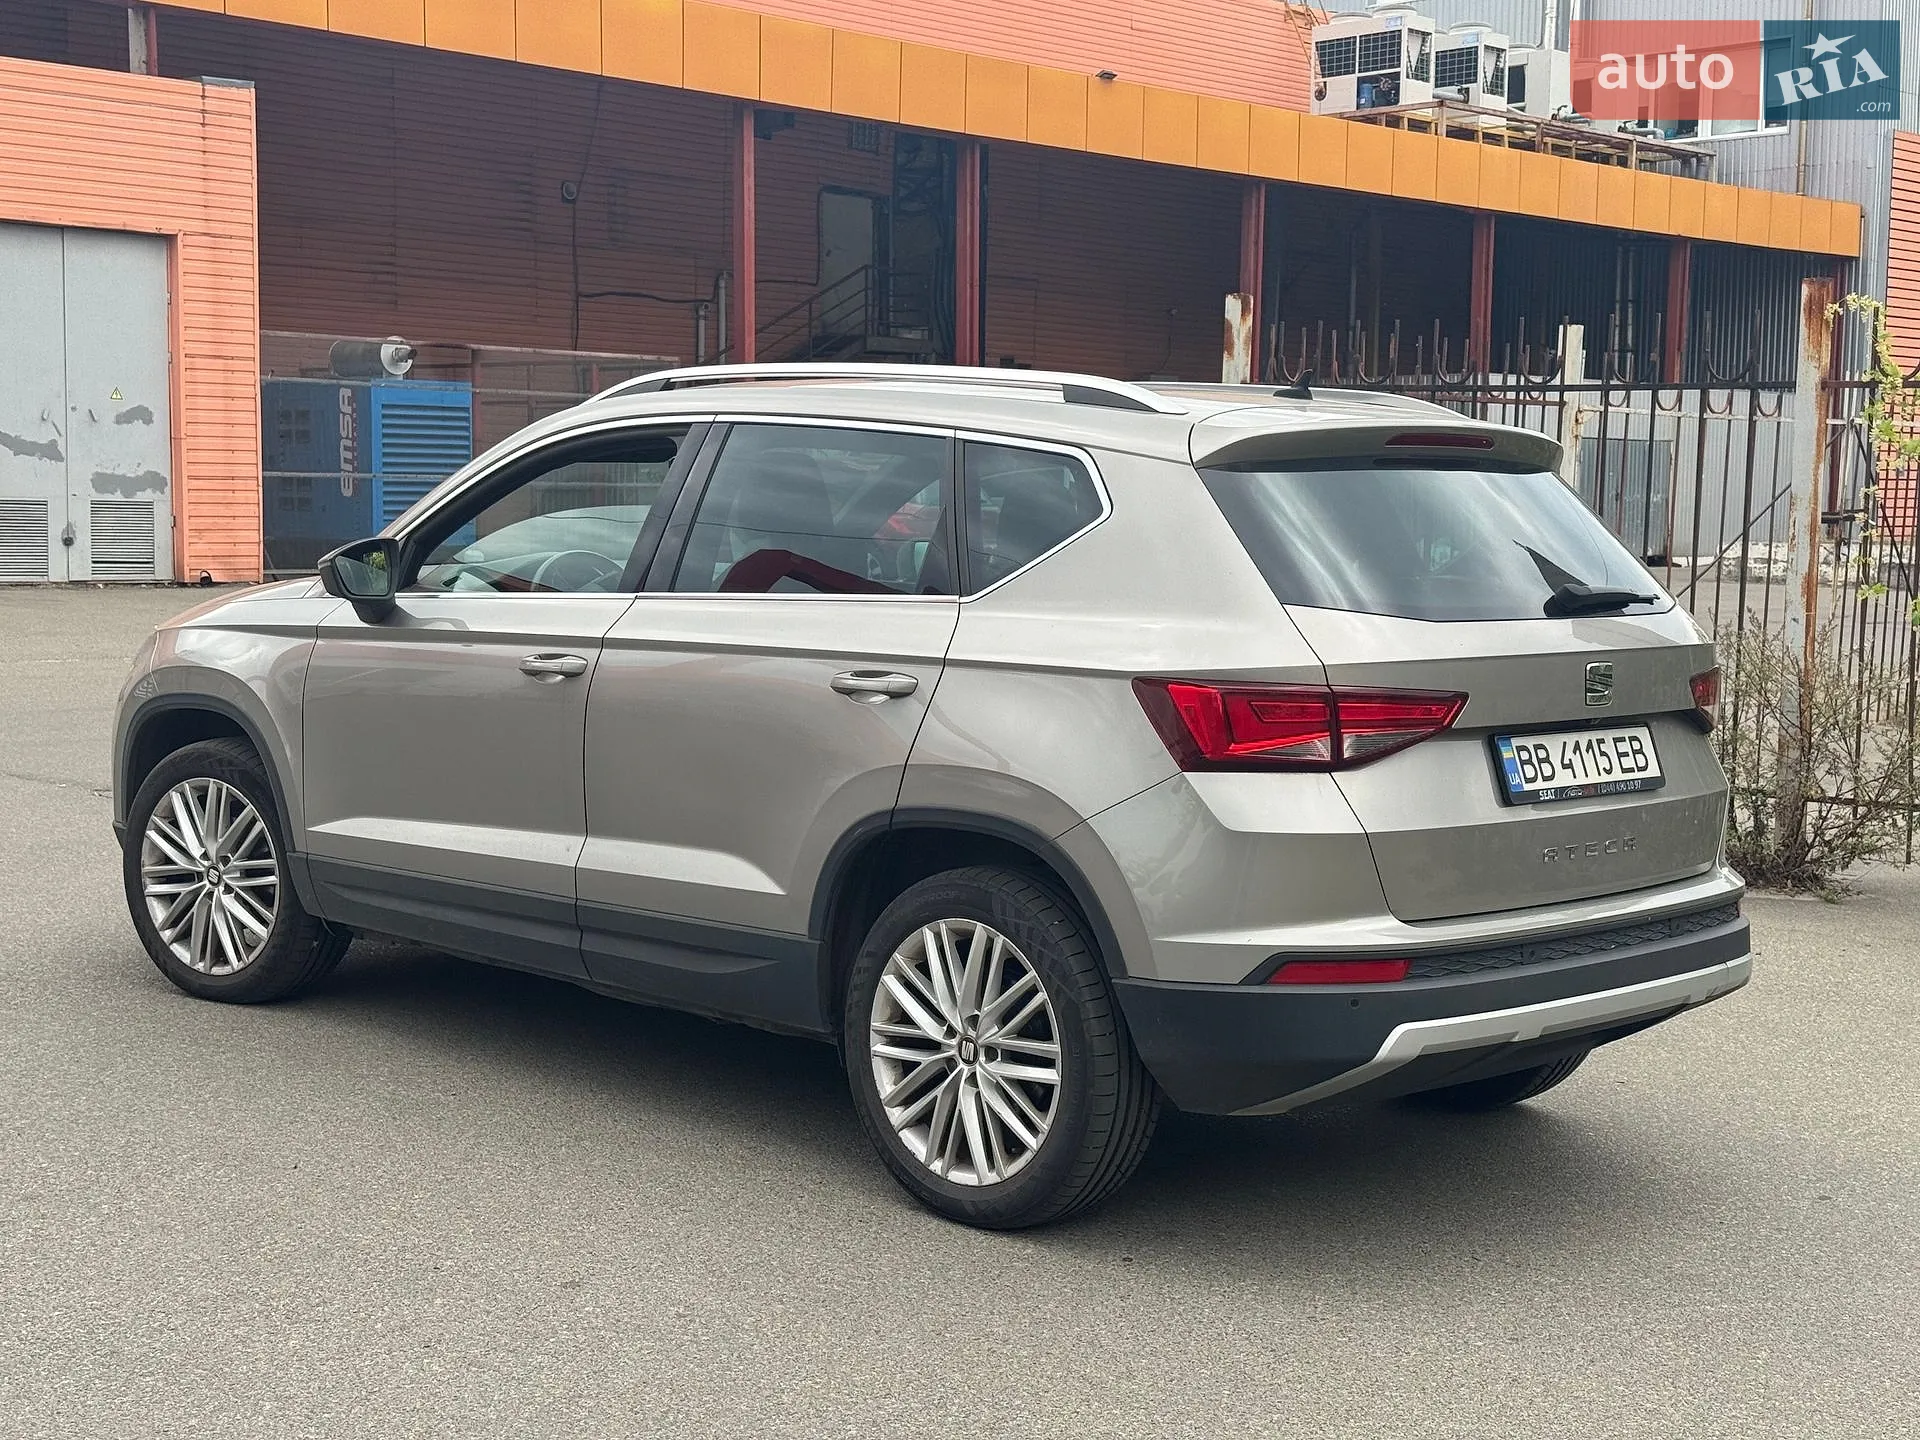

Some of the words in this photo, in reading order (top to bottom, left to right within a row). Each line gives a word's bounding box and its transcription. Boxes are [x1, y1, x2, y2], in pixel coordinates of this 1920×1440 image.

[1515, 743, 1556, 784] BB
[1560, 738, 1613, 779] 4115
[1612, 735, 1649, 774] EB
[1508, 773, 1523, 785] UA
[1539, 788, 1556, 801] SEAT
[1542, 835, 1637, 864] ATECA
